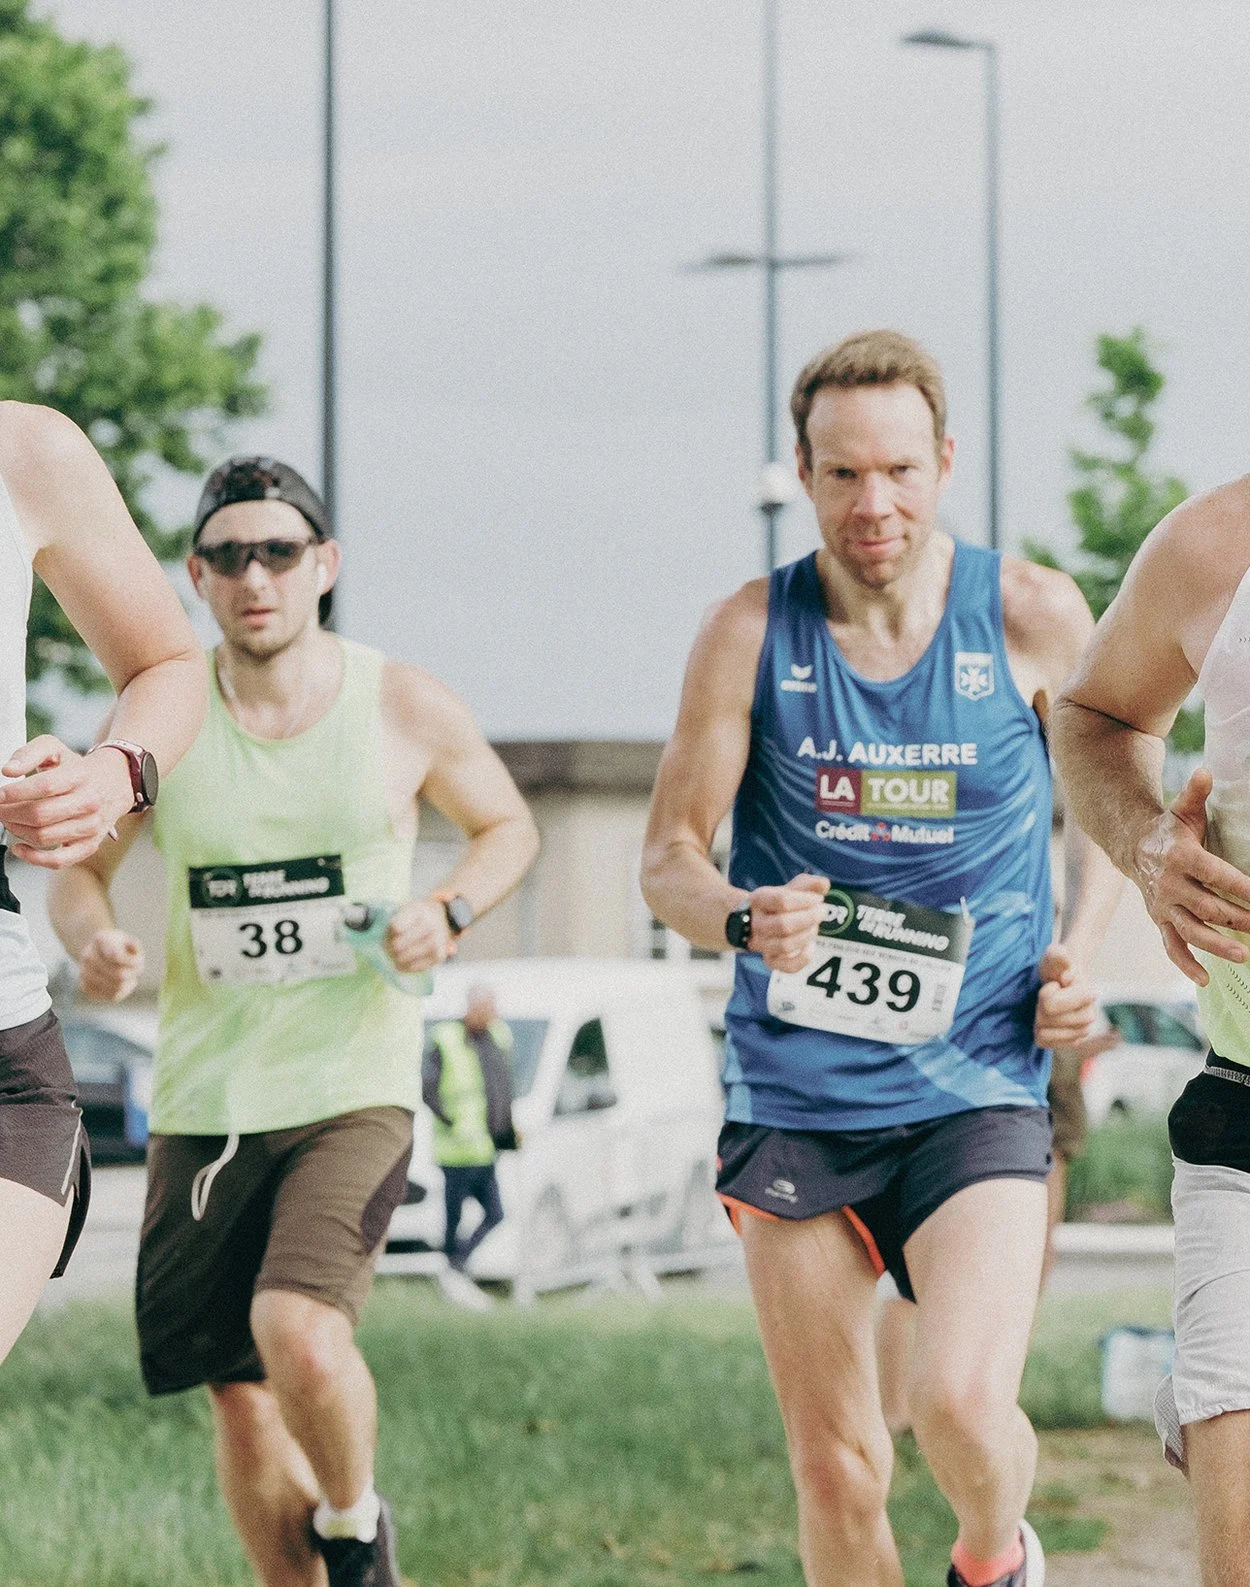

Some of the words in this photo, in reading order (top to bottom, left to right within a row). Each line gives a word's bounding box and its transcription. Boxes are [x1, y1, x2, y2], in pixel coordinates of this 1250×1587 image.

[796, 736, 843, 762] A.J.
[847, 741, 978, 766] AUXERRE
[819, 774, 856, 801] LA
[867, 777, 950, 804] TOUR
[239, 919, 303, 958] 38
[806, 956, 921, 1013] 439
